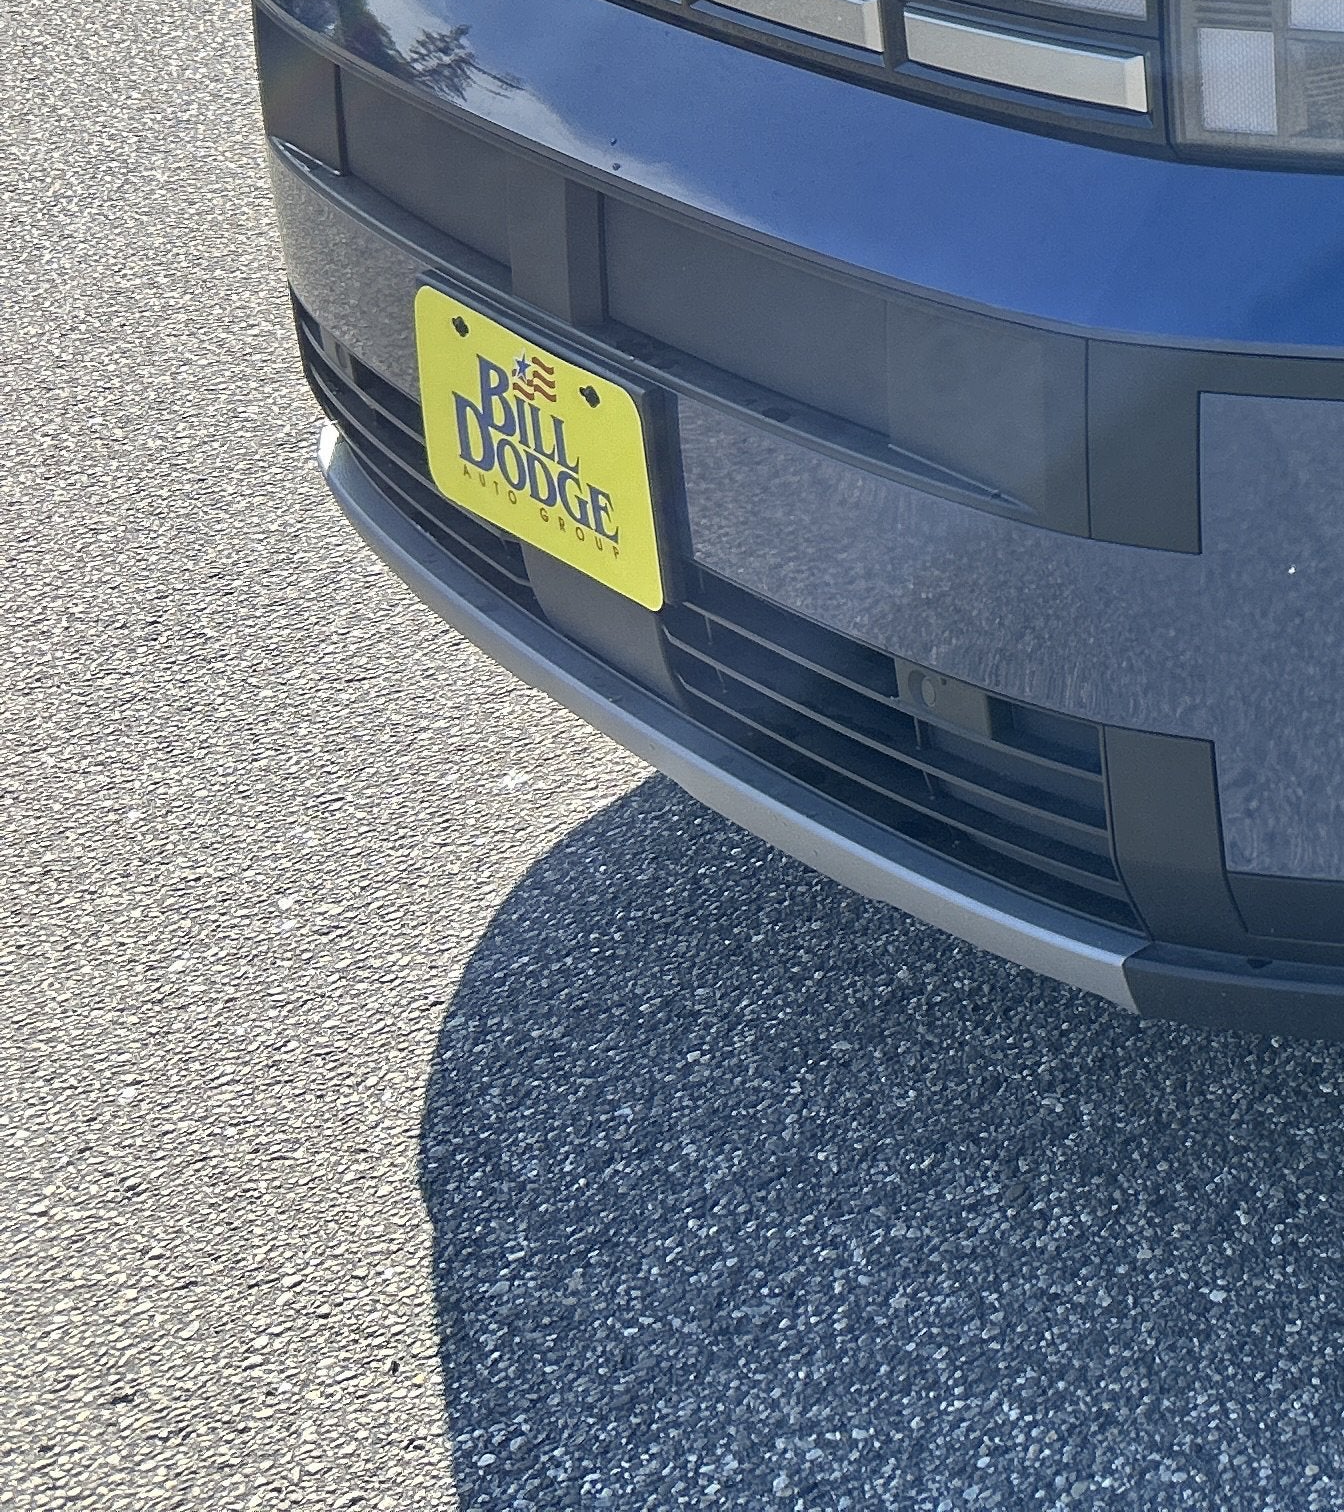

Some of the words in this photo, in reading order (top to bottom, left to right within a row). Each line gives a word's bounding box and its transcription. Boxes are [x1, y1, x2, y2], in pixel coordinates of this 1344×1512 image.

[452, 390, 619, 545] DODGE
[476, 353, 580, 475] BILL
[463, 463, 517, 505] AUTO
[539, 507, 620, 560] GROUP
